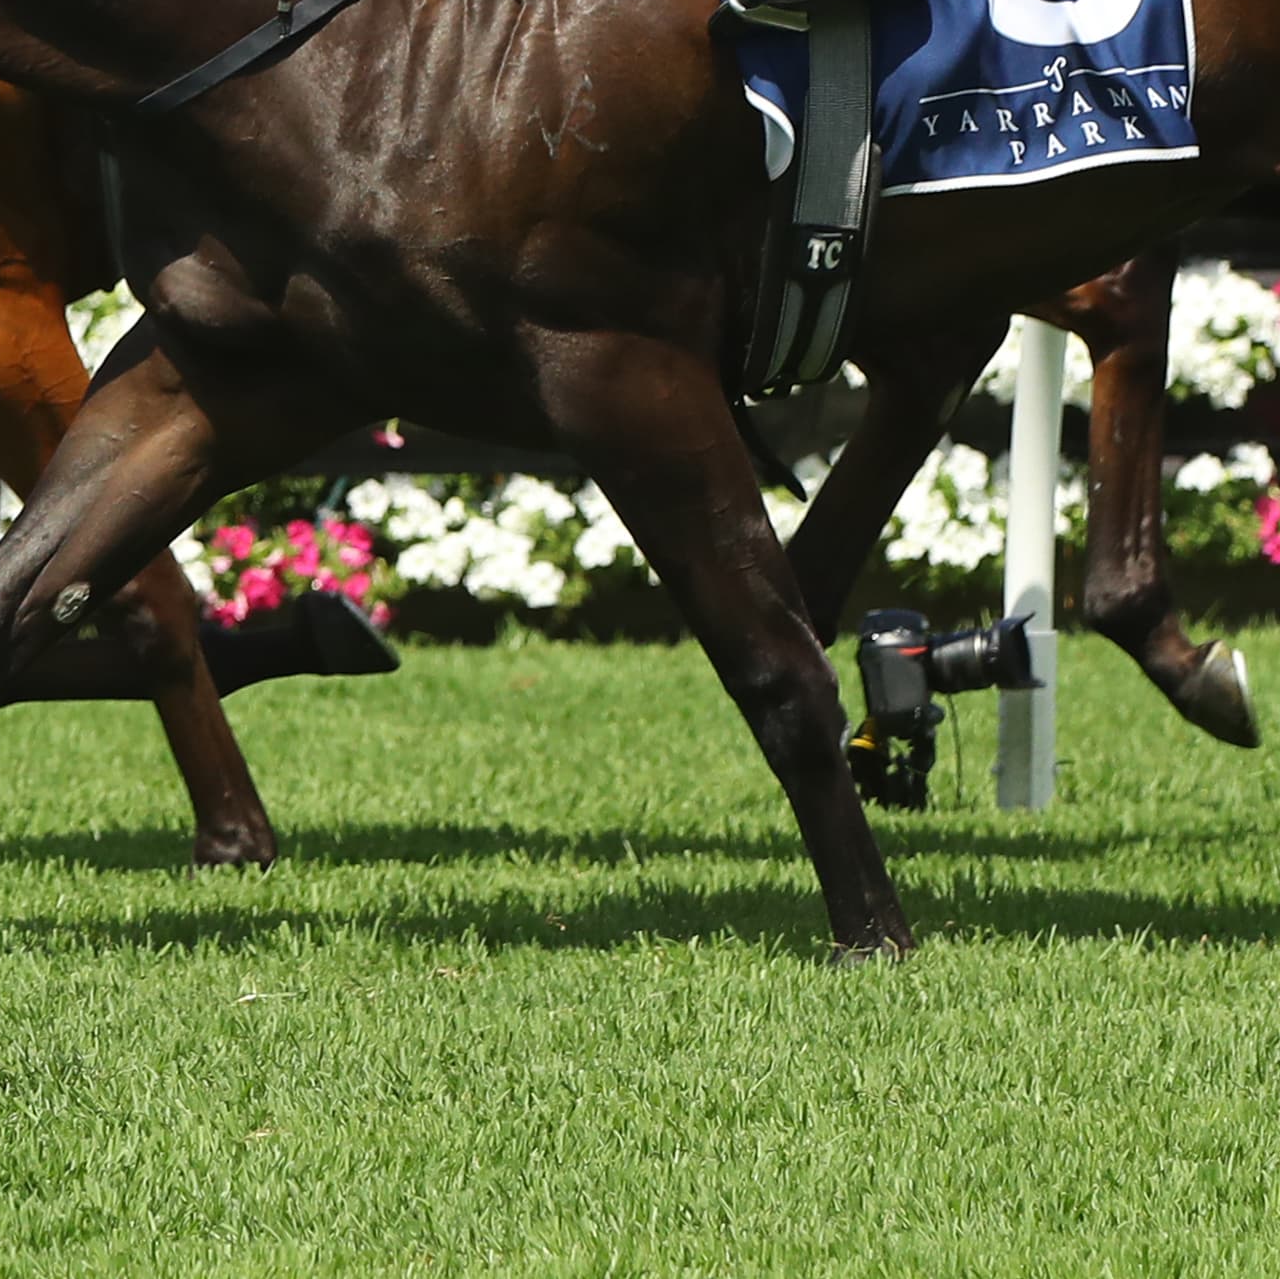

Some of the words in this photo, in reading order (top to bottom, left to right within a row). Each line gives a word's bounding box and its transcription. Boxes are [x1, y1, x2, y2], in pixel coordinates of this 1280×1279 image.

[923, 85, 1187, 137] YARRAMAN
[1010, 116, 1145, 165] PARK
[807, 237, 843, 269] TC
